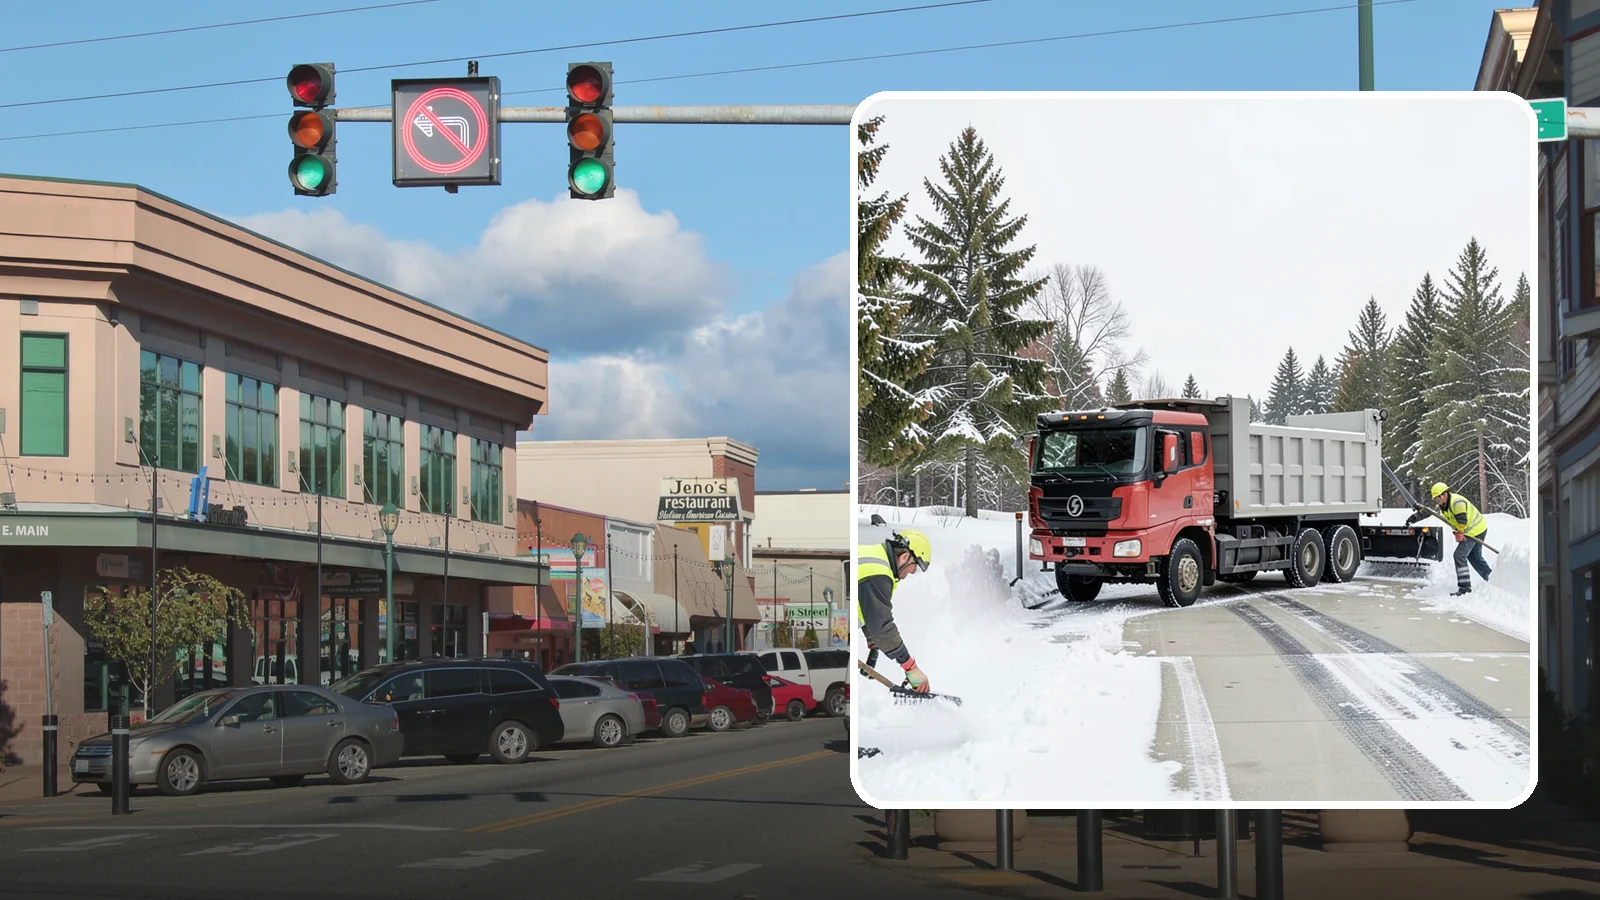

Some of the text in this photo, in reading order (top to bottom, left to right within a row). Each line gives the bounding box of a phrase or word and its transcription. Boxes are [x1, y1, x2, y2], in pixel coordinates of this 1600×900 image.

[670, 480, 727, 494] Jeno's
[665, 496, 731, 509] restaurant
[659, 510, 681, 519] Italian
[686, 510, 714, 519] American
[715, 510, 737, 519] Cuisine
[2, 525, 49, 536] E. MAIN
[797, 607, 828, 616] Street
